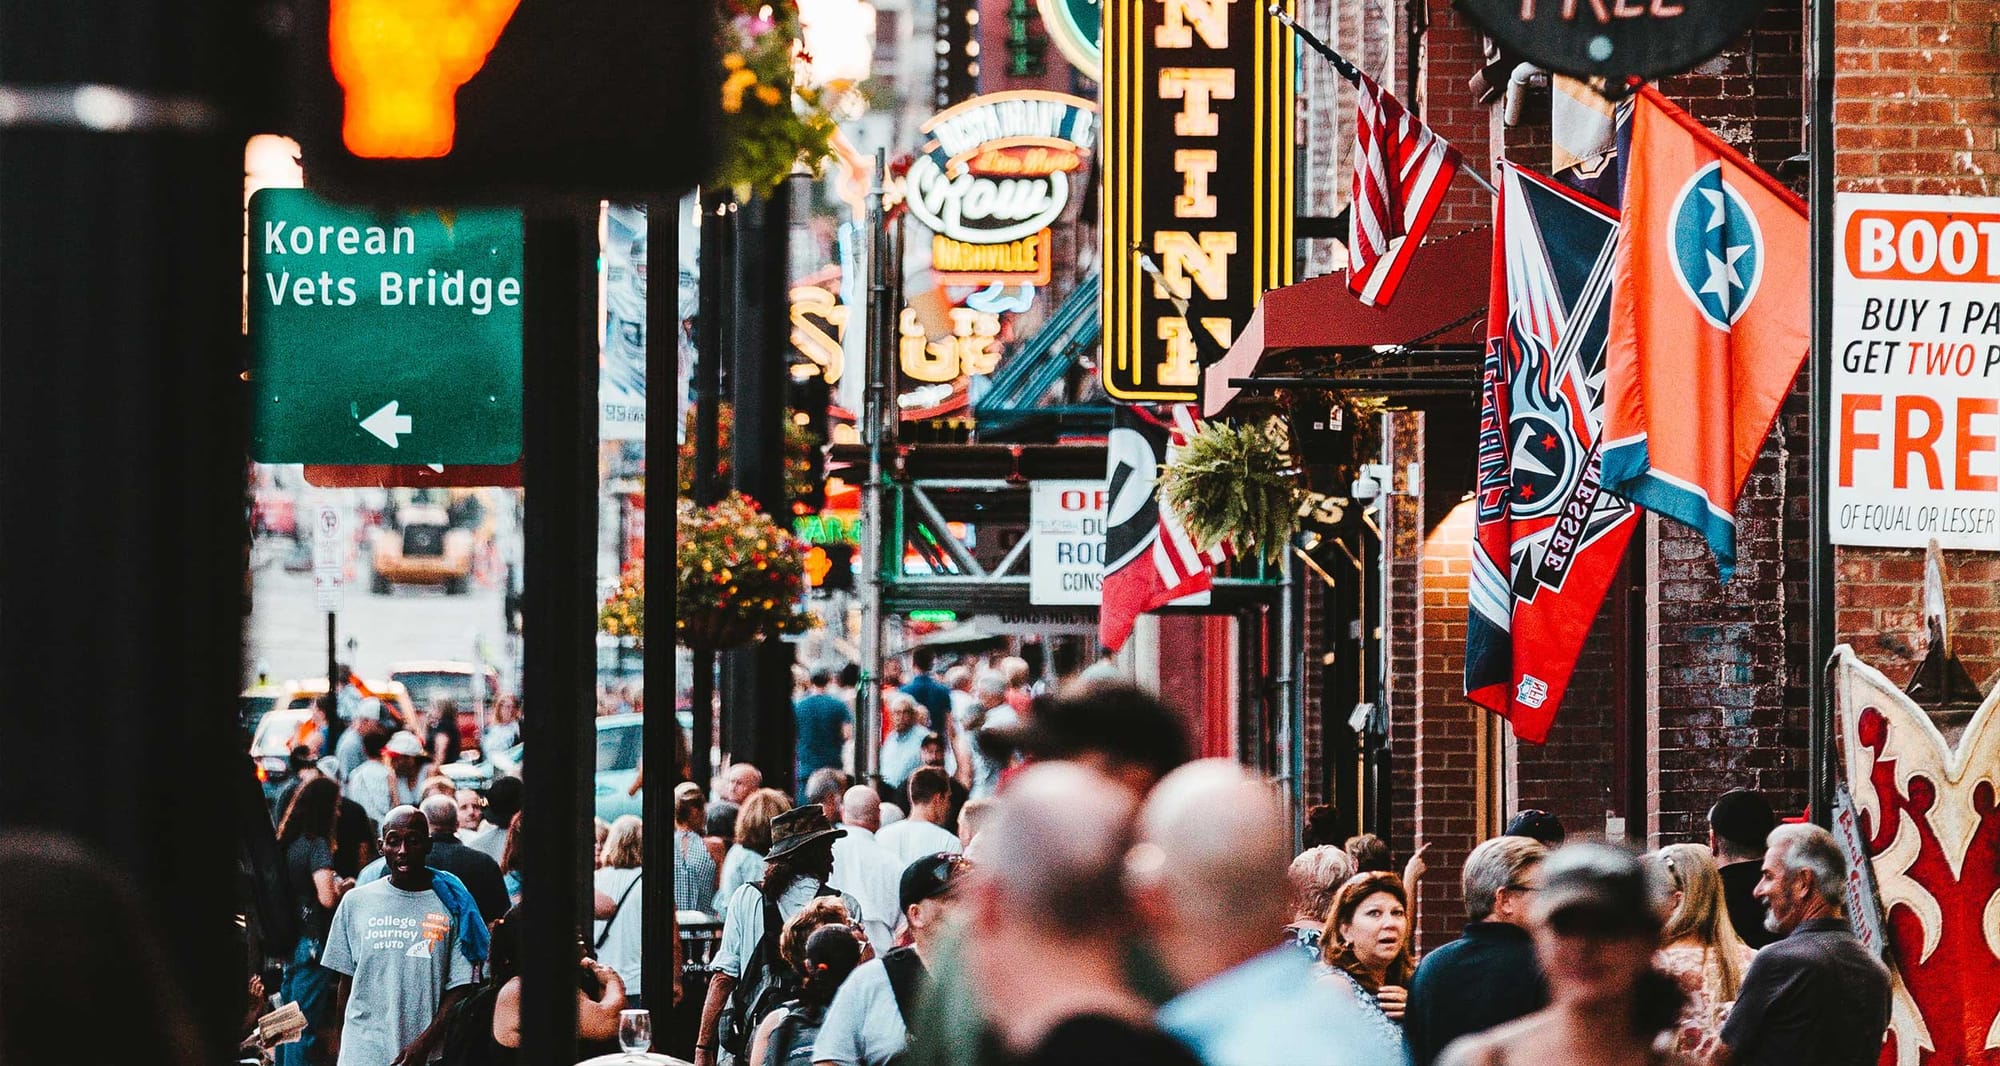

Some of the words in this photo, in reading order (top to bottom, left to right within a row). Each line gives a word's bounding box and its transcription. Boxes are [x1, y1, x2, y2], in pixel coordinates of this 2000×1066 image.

[265, 220, 415, 254] Korean
[266, 270, 357, 306] Vets
[380, 268, 521, 315] Bridge
[1861, 298, 1929, 333] BUY
[1938, 301, 1952, 333] 1
[1842, 340, 1901, 374] GET
[1907, 341, 1976, 377] TWO
[1838, 393, 2000, 492] FRE
[1841, 504, 1862, 530] OF
[1863, 504, 1912, 532] EQUAL
[1917, 505, 1938, 533] OR
[1941, 507, 1996, 535] LESSER
[364, 929, 418, 942] Journey
[367, 915, 417, 929] College
[373, 942, 384, 950] at
[384, 940, 405, 949] UTD
